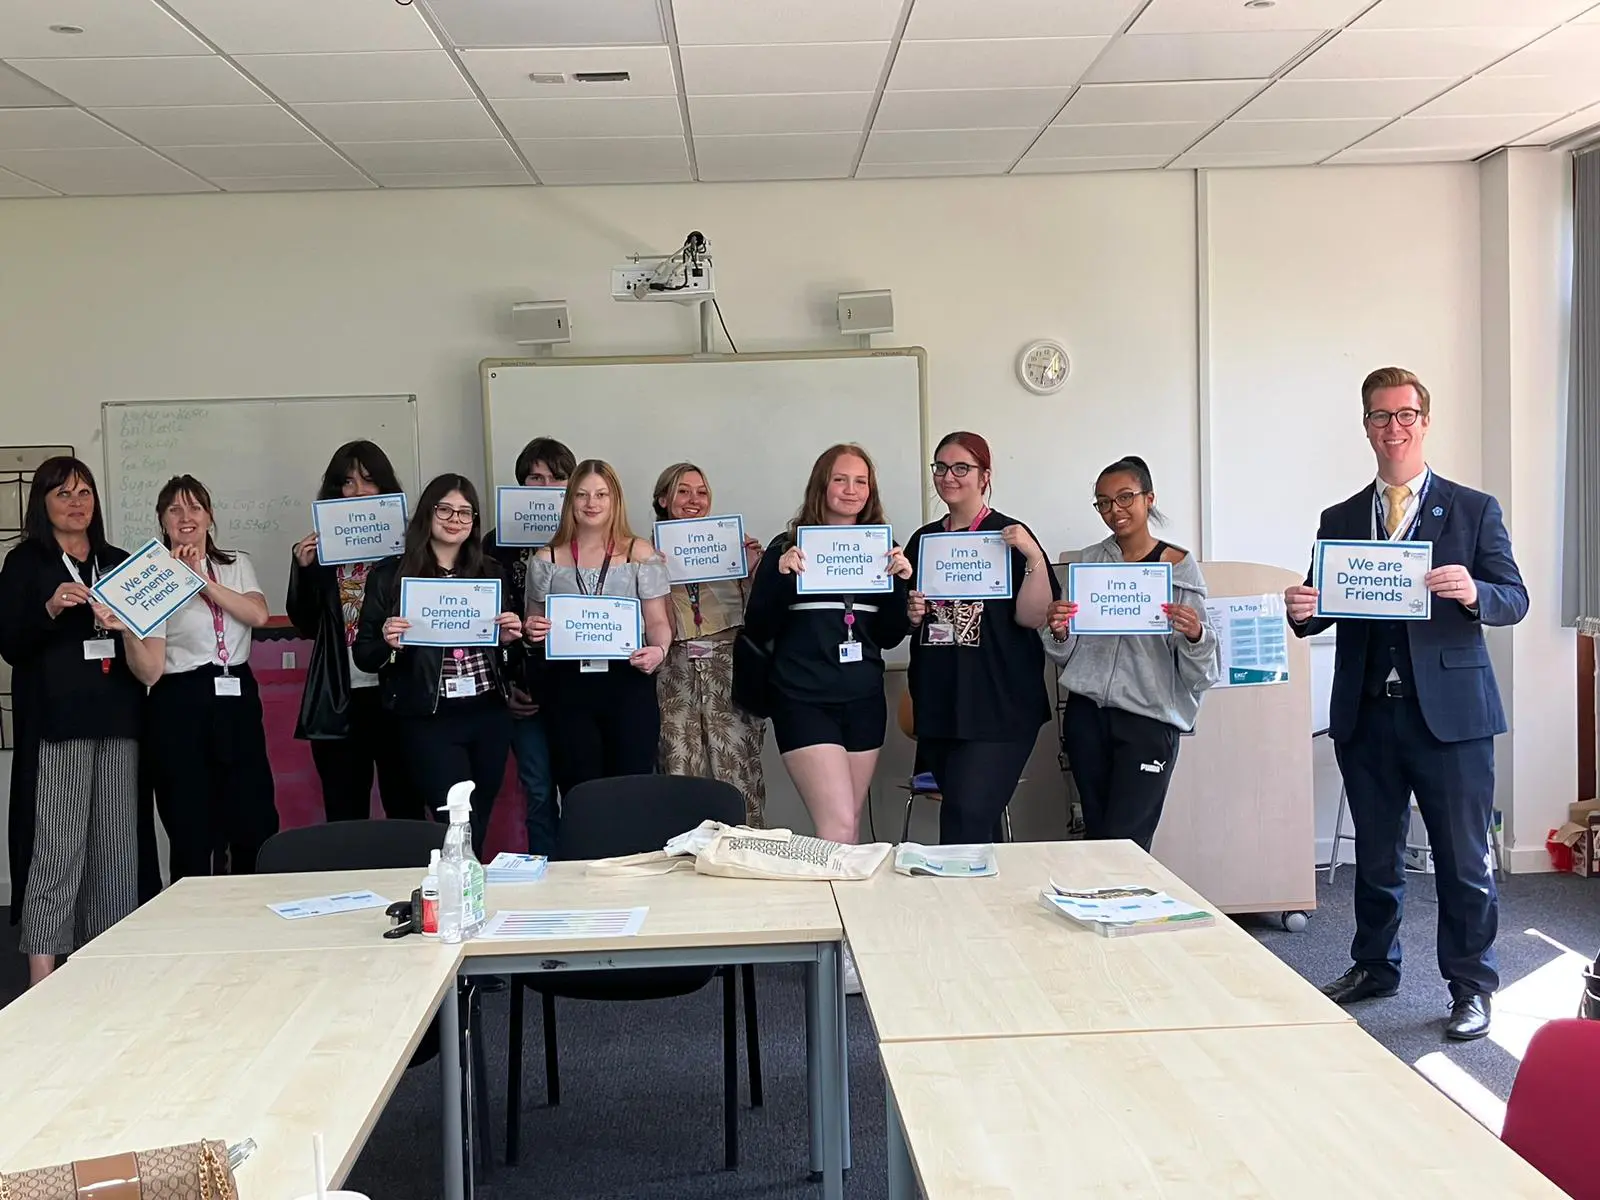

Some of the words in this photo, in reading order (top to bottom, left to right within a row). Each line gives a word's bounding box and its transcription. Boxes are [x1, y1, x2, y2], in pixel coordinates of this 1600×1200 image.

[529, 501, 546, 510] I'm
[348, 512, 366, 522] I'm
[369, 512, 376, 520] a
[514, 512, 560, 522] Dementi
[334, 522, 390, 536] Dementia
[524, 522, 558, 532] Friend
[345, 533, 382, 546] Friend
[688, 533, 704, 543] I'm
[707, 534, 714, 542] a
[674, 542, 727, 556] Dementia
[832, 542, 850, 552] I'm
[852, 543, 860, 552] a
[816, 553, 873, 564] Dementia
[952, 548, 968, 558] I'm
[971, 549, 978, 558] a
[684, 554, 719, 566] Friend
[936, 559, 992, 570] Dementia
[1348, 558, 1374, 570] We
[1378, 562, 1402, 572] are
[826, 565, 864, 576] Friend
[120, 576, 142, 592] We
[140, 564, 158, 580] are
[945, 572, 982, 582] Friend
[1337, 572, 1412, 588] Dementia
[124, 568, 174, 606] Dementia
[1108, 580, 1126, 590] I'm
[1129, 582, 1137, 590] a
[140, 580, 179, 612] Friends
[440, 595, 457, 605] I'm
[460, 598, 468, 606] a
[1090, 592, 1151, 603] Dementia
[1345, 588, 1402, 602] Friends
[422, 607, 480, 618] Dementia
[1100, 605, 1140, 616] Friend
[1245, 604, 1258, 612] Top
[582, 610, 599, 619] I'm
[431, 620, 470, 630] Friend
[566, 620, 622, 631] Dementia
[575, 632, 612, 642] Friend
